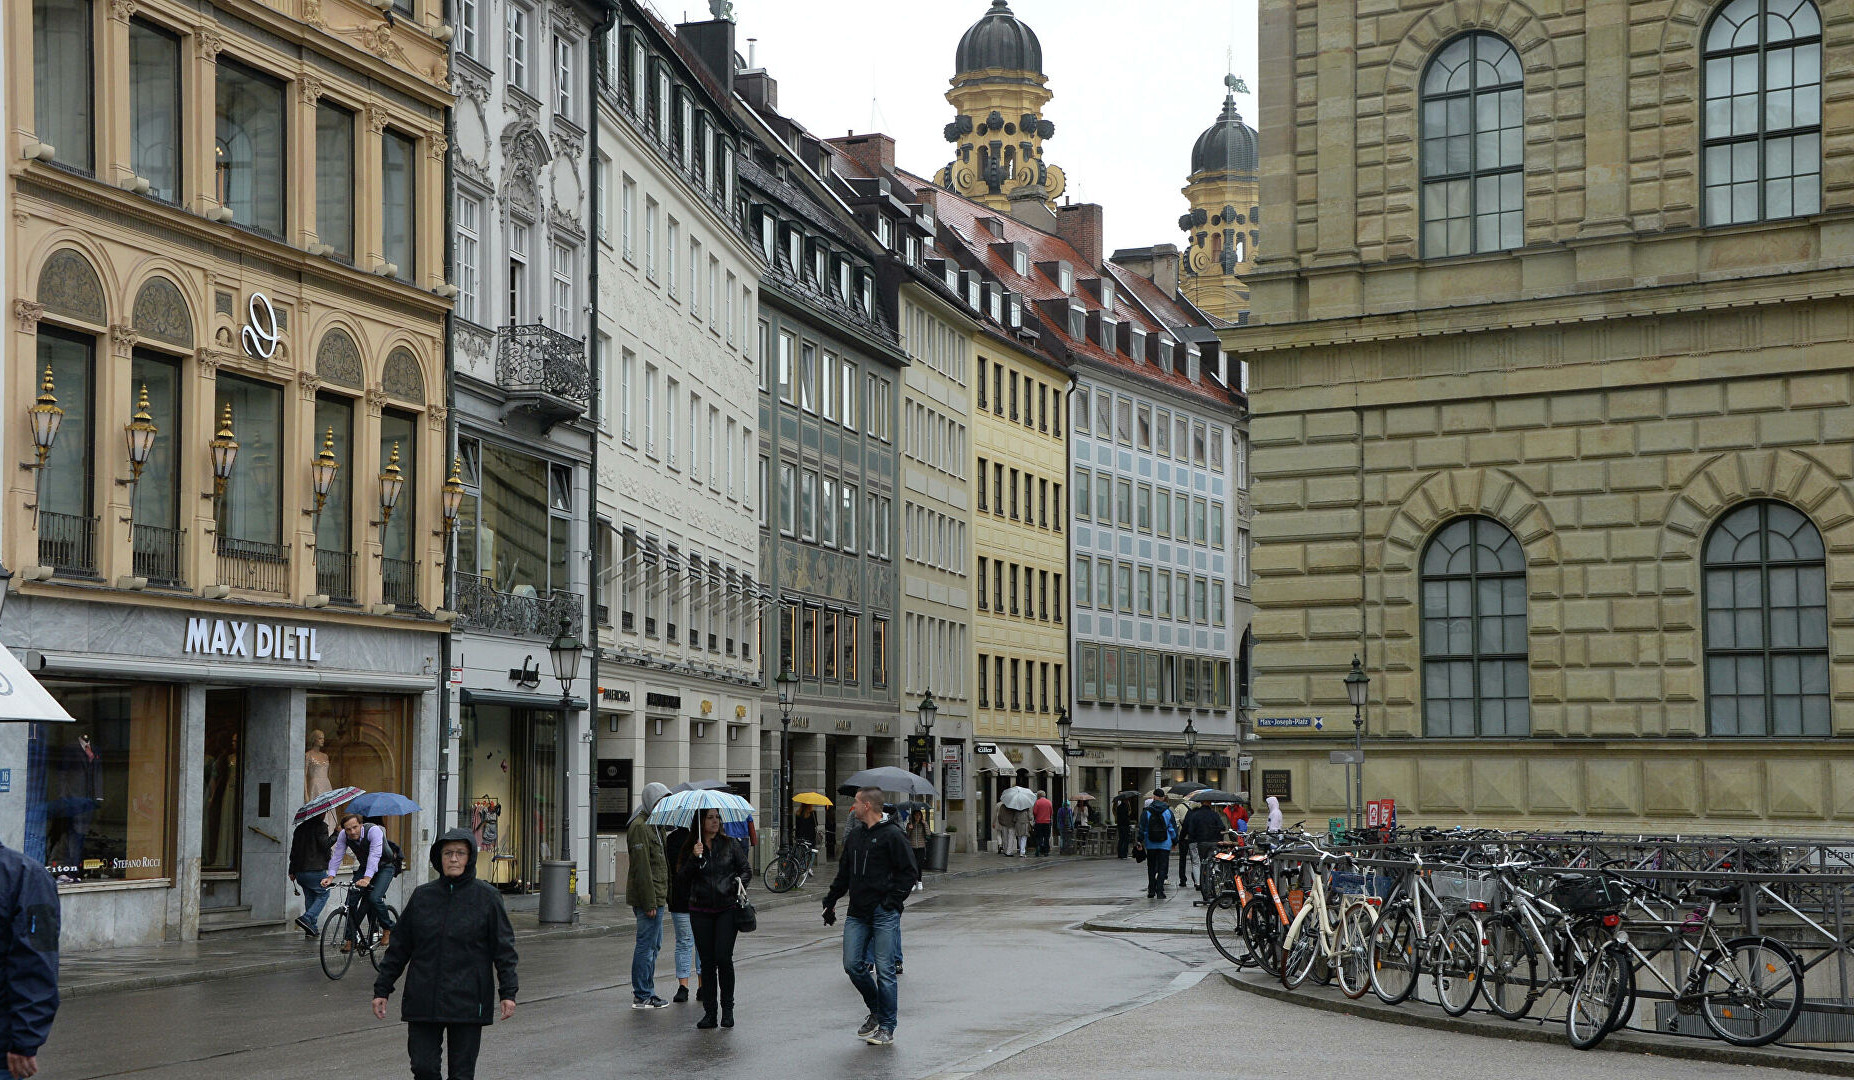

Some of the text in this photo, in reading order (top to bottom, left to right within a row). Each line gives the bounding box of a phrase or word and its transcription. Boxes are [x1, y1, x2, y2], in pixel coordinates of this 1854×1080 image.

[185, 617, 321, 661] MAX DIETL
[2, 771, 9, 782] 16
